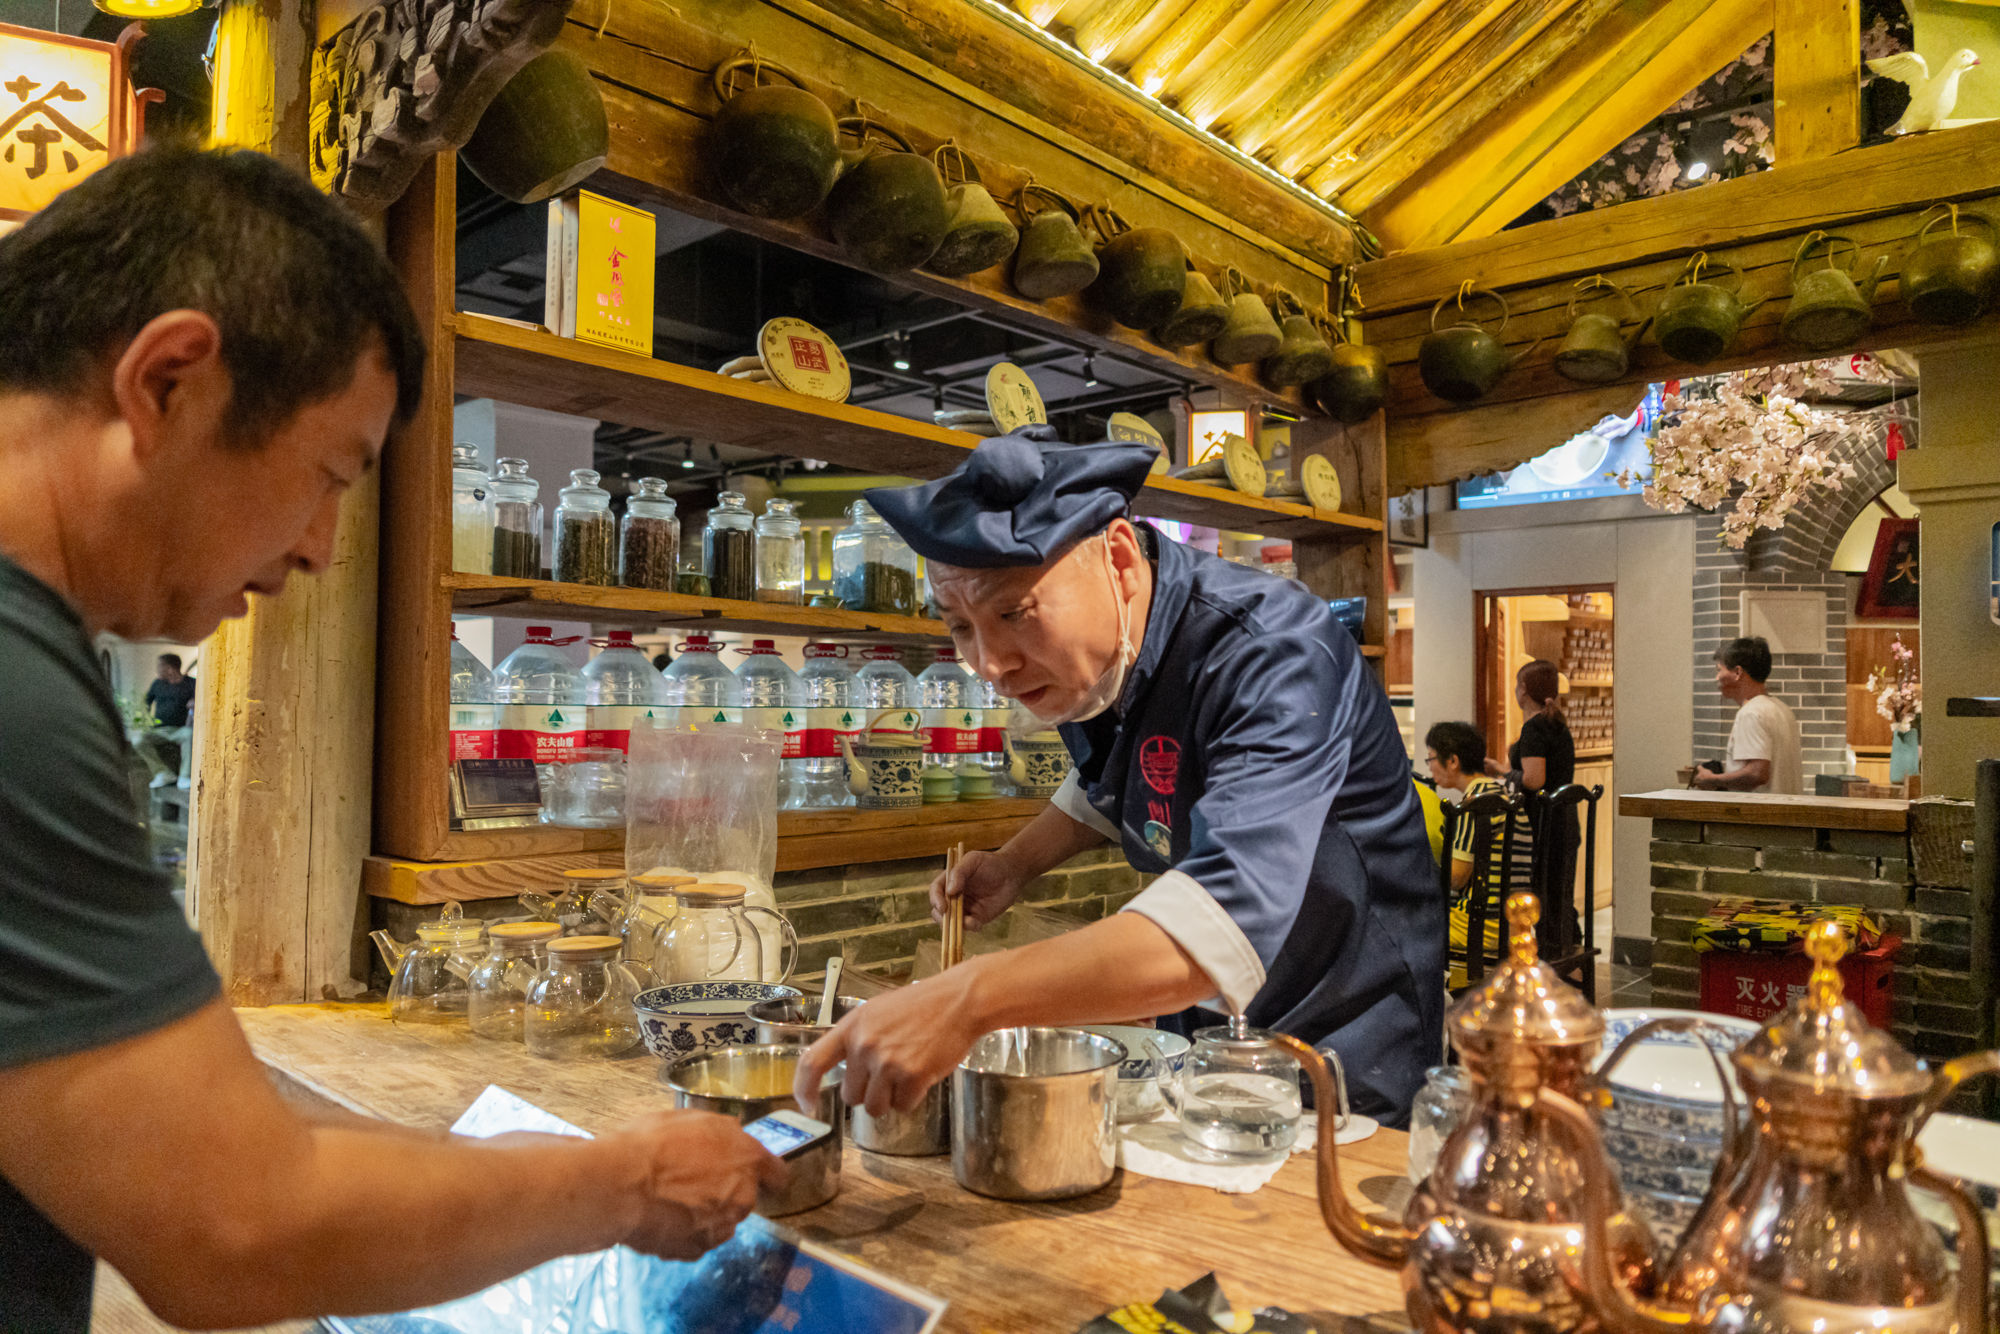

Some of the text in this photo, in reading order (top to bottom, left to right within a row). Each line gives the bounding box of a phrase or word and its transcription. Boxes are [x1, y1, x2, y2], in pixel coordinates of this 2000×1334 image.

[0, 75, 108, 180] 茶
[1888, 553, 1919, 584] 大
[1735, 976, 1809, 1007] 灭火器
[1736, 1004, 1753, 1017] FIRE
